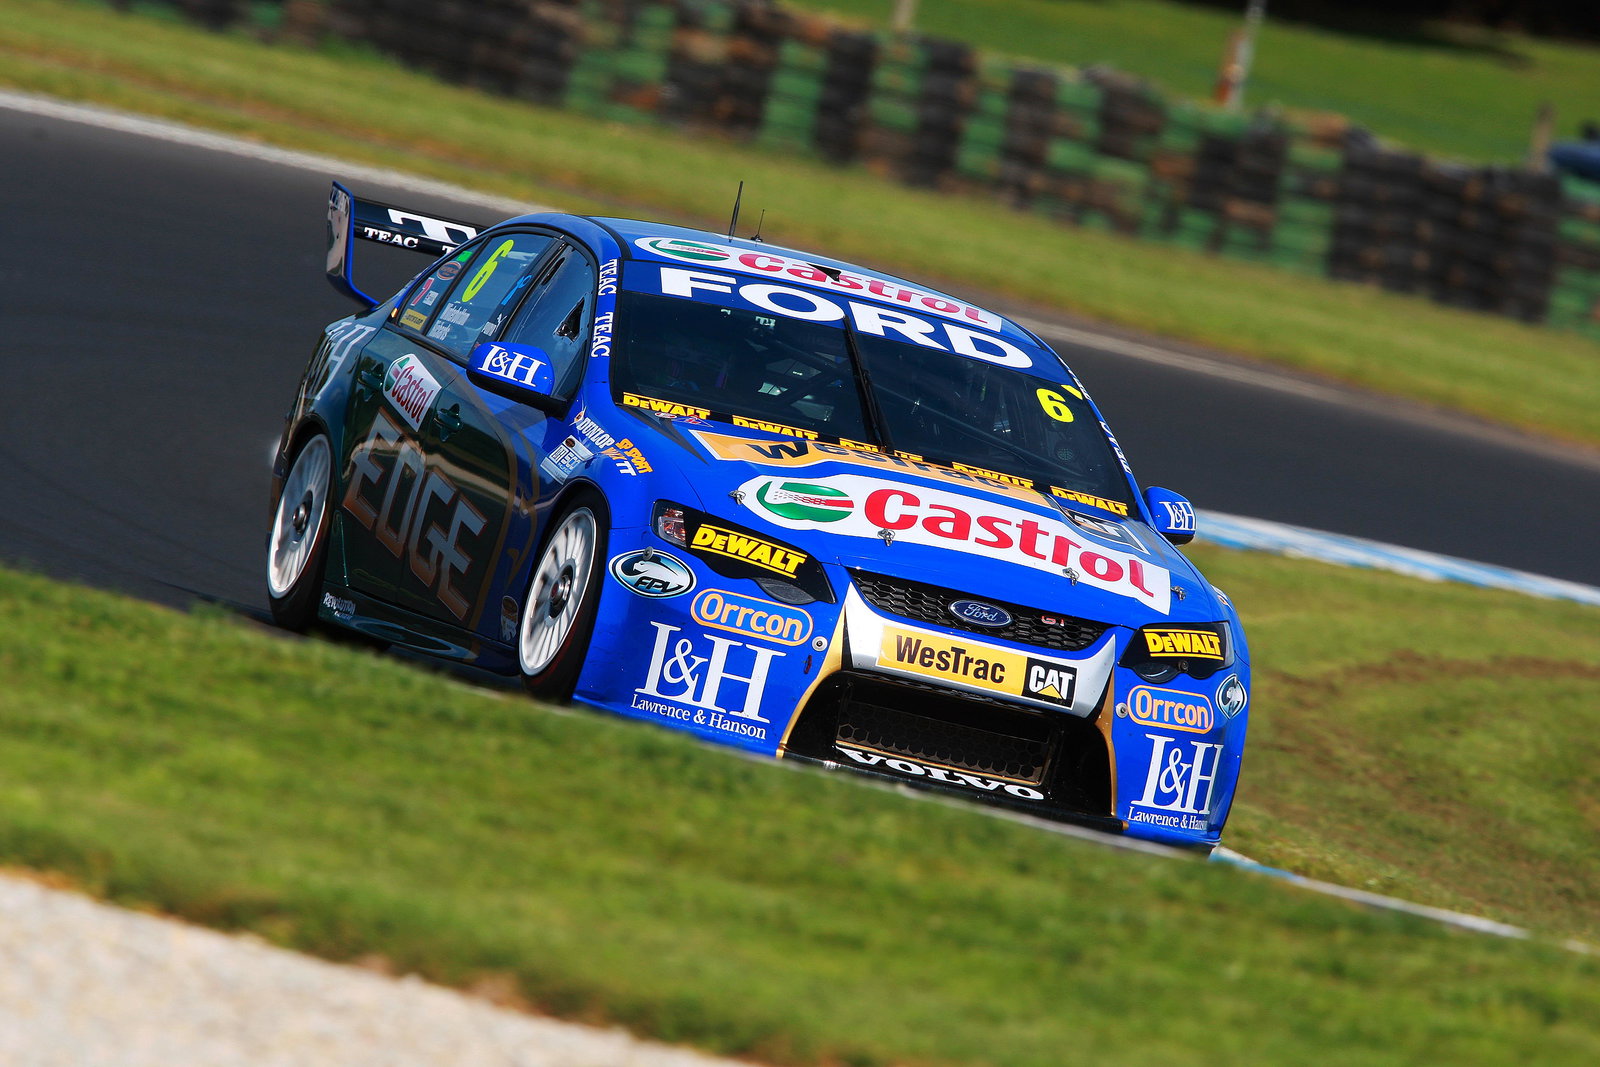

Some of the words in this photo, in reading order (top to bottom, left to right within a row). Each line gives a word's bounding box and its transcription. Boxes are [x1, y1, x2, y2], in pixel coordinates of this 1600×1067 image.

[364, 227, 420, 249] TEAC
[462, 239, 515, 303] 6
[598, 258, 618, 296] TEAC
[738, 253, 991, 325] Castrol
[590, 311, 614, 358] TEAC
[660, 267, 1034, 369] FORD
[391, 365, 434, 424] Castrol
[1036, 388, 1074, 423] 6
[576, 417, 616, 449] DUNLOP
[342, 406, 488, 621] EDGE
[864, 488, 1154, 598] Castrol
[634, 576, 684, 592] FPV
[700, 593, 803, 640] Orrcon
[964, 603, 999, 621] Ford
[635, 621, 786, 723] L&H
[896, 634, 1005, 684] WesTrac
[1029, 664, 1074, 700] CAT
[631, 694, 690, 721] Lawrence
[693, 709, 707, 724] &
[708, 712, 766, 740] Hanson
[1136, 689, 1209, 729] Orrcon
[835, 746, 1045, 800] VOLVO
[1127, 806, 1179, 828] Lawrence
[1180, 814, 1188, 829] &
